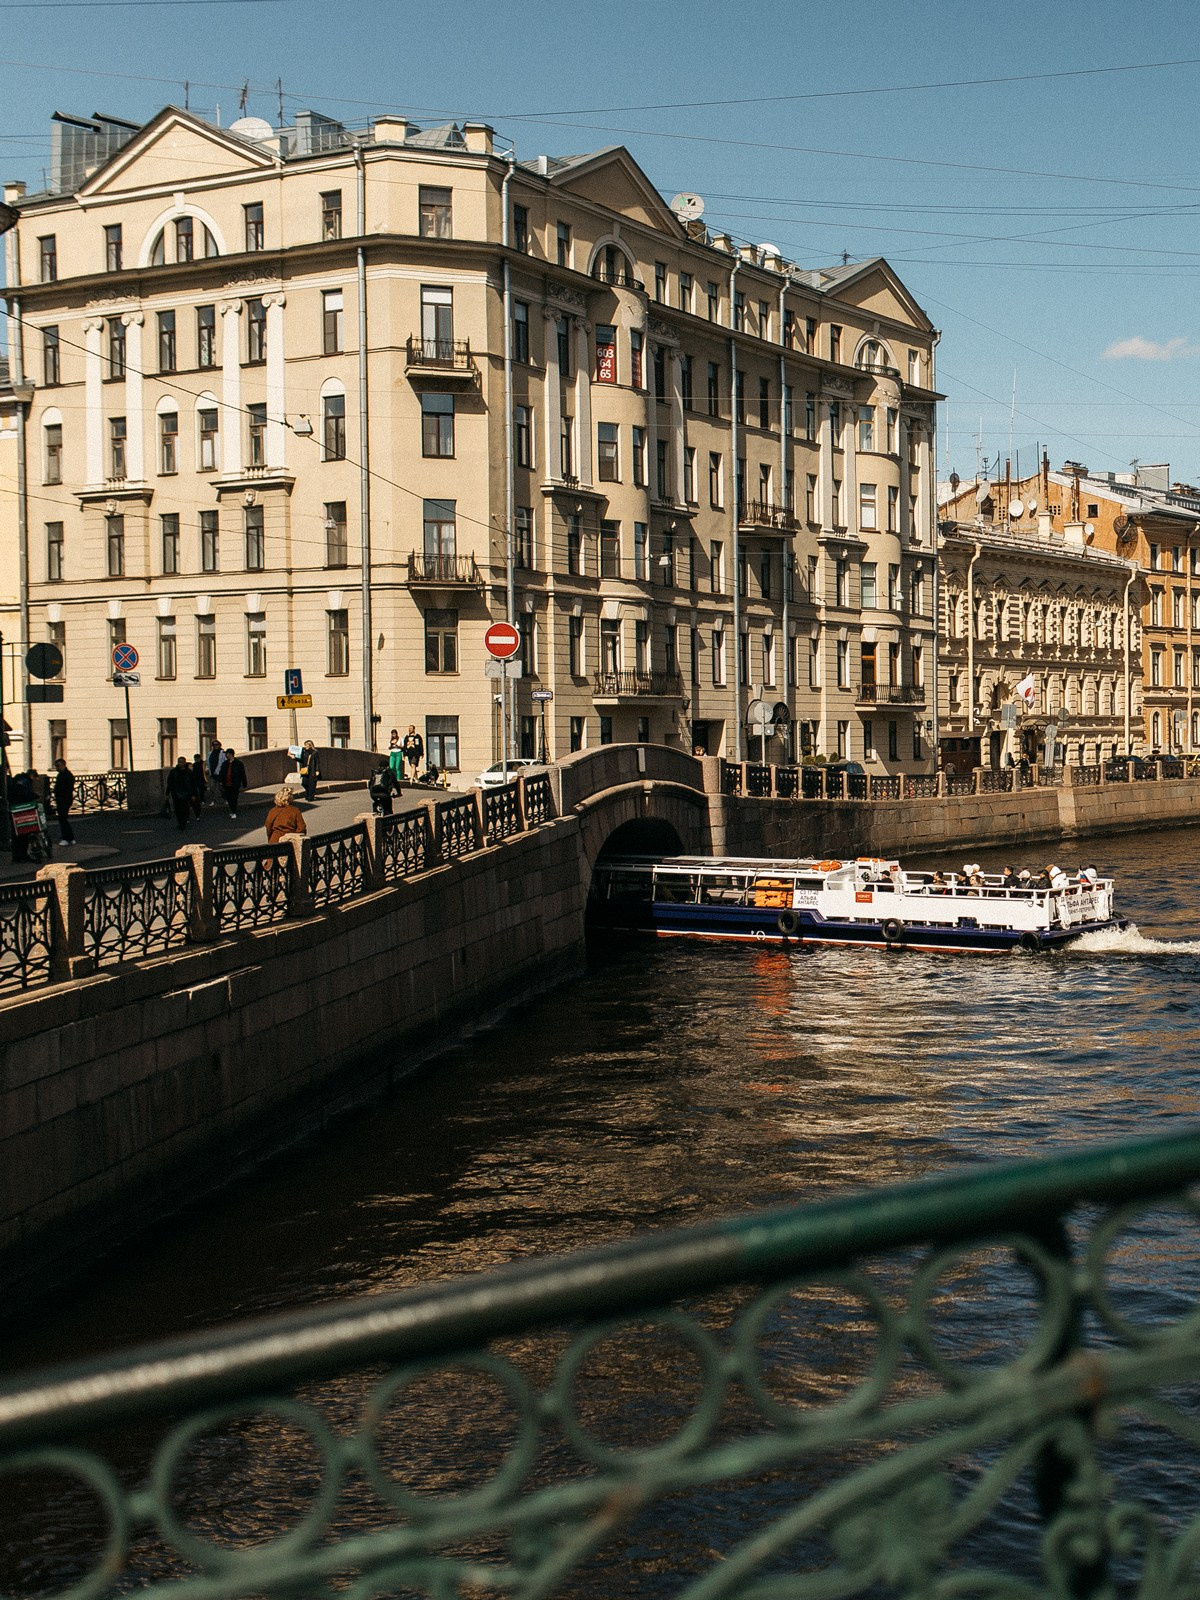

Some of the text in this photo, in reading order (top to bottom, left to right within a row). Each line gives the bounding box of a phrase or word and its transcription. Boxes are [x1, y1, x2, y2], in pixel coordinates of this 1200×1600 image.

[597, 348, 614, 359] 603
[599, 359, 612, 368] 64
[599, 369, 612, 379] 65
